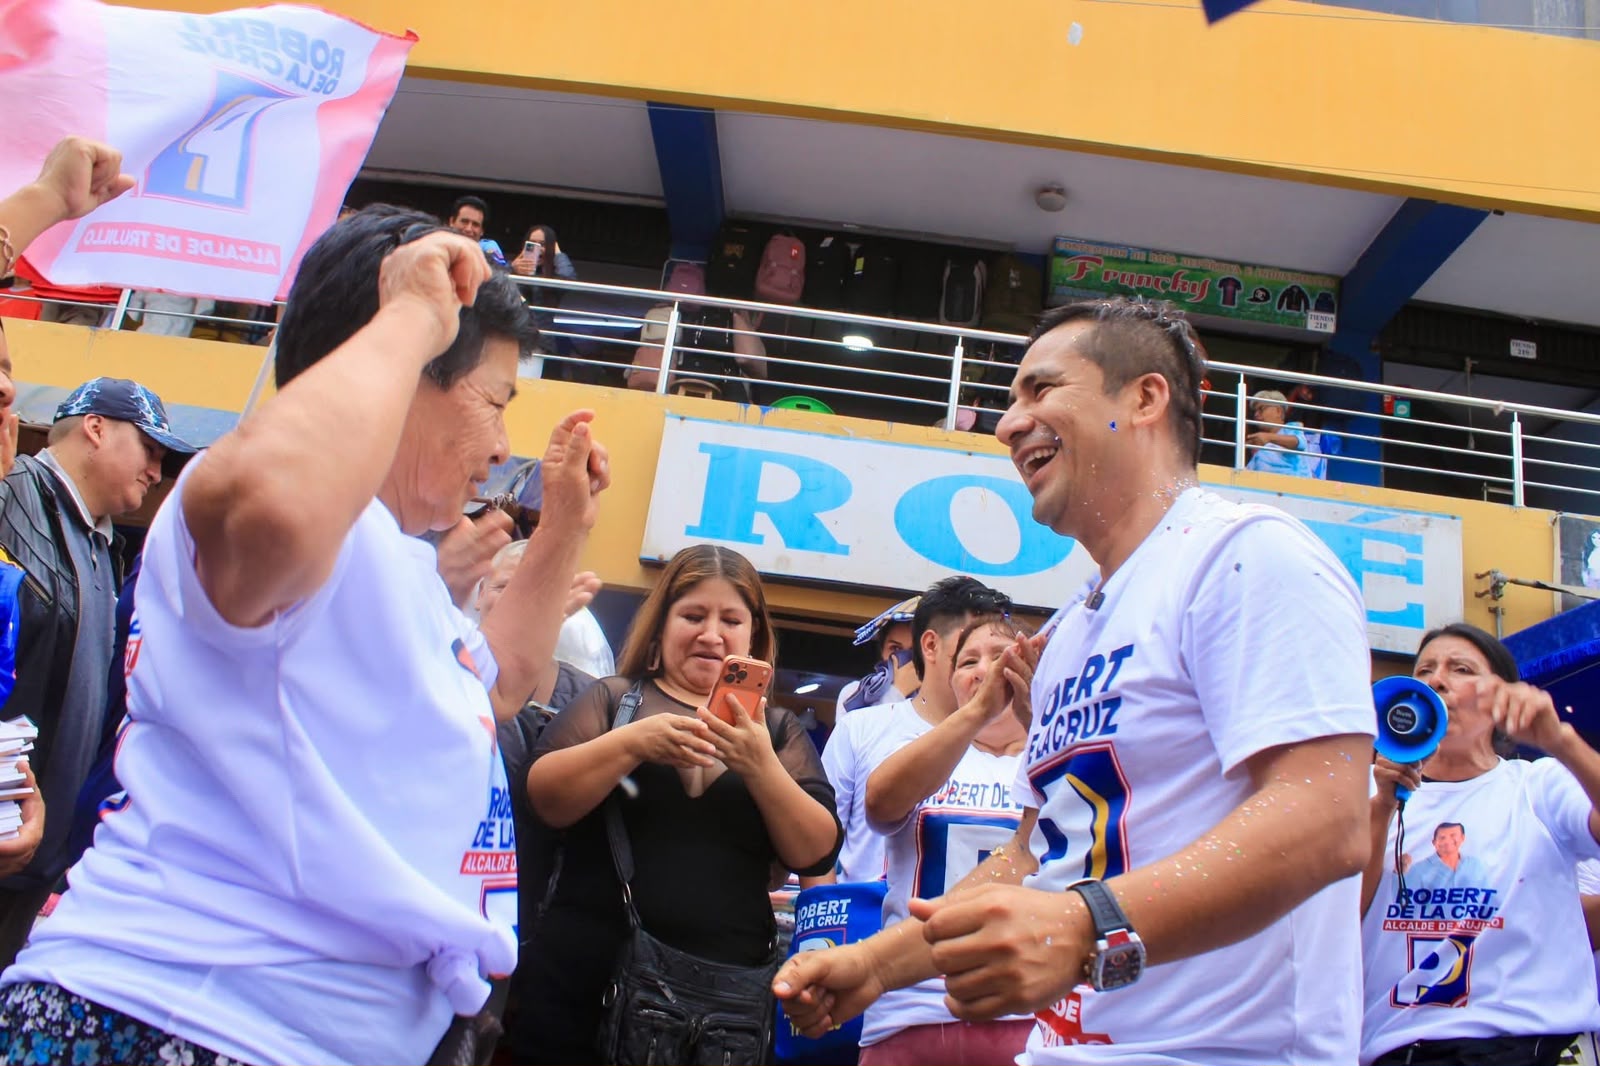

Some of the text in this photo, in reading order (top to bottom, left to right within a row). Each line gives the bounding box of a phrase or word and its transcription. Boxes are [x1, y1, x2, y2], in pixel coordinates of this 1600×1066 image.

[1309, 313, 1334, 323] TIENDA
[1314, 321, 1328, 331] 218
[1053, 696, 1121, 751] CRUZ
[991, 782, 1011, 809] DE
[472, 821, 495, 848] DE
[463, 853, 509, 872] ALCALDE
[1396, 887, 1497, 905] ROBERT
[1386, 904, 1498, 919] DE LA CRU
[804, 918, 814, 931] LA
[817, 914, 848, 927] CRUZ
[1385, 920, 1435, 931] ALCALDE
[1438, 921, 1455, 931] DE
